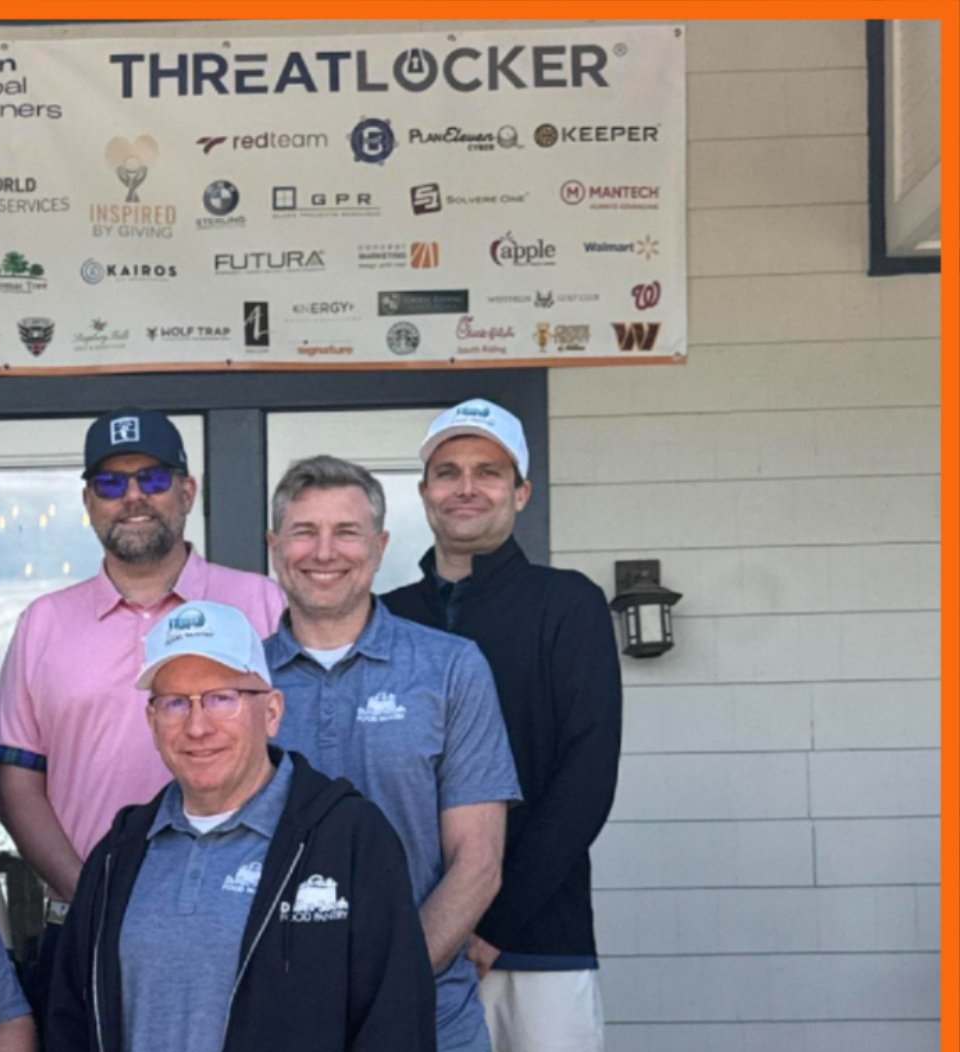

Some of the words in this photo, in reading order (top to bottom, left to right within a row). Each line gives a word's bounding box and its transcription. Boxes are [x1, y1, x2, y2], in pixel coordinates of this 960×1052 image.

[233, 132, 328, 150] redteam
[562, 126, 659, 142] KEEPER
[589, 186, 660, 199] MANTECH
[90, 204, 177, 225] INSPIRED
[92, 225, 116, 238] BY
[118, 225, 174, 239] GIVING
[584, 242, 635, 253] Walmart
[214, 251, 325, 271] FUTURA
[106, 264, 178, 277] KAIROS
[161, 327, 194, 338] WOLF
[197, 326, 231, 337] TRAP
